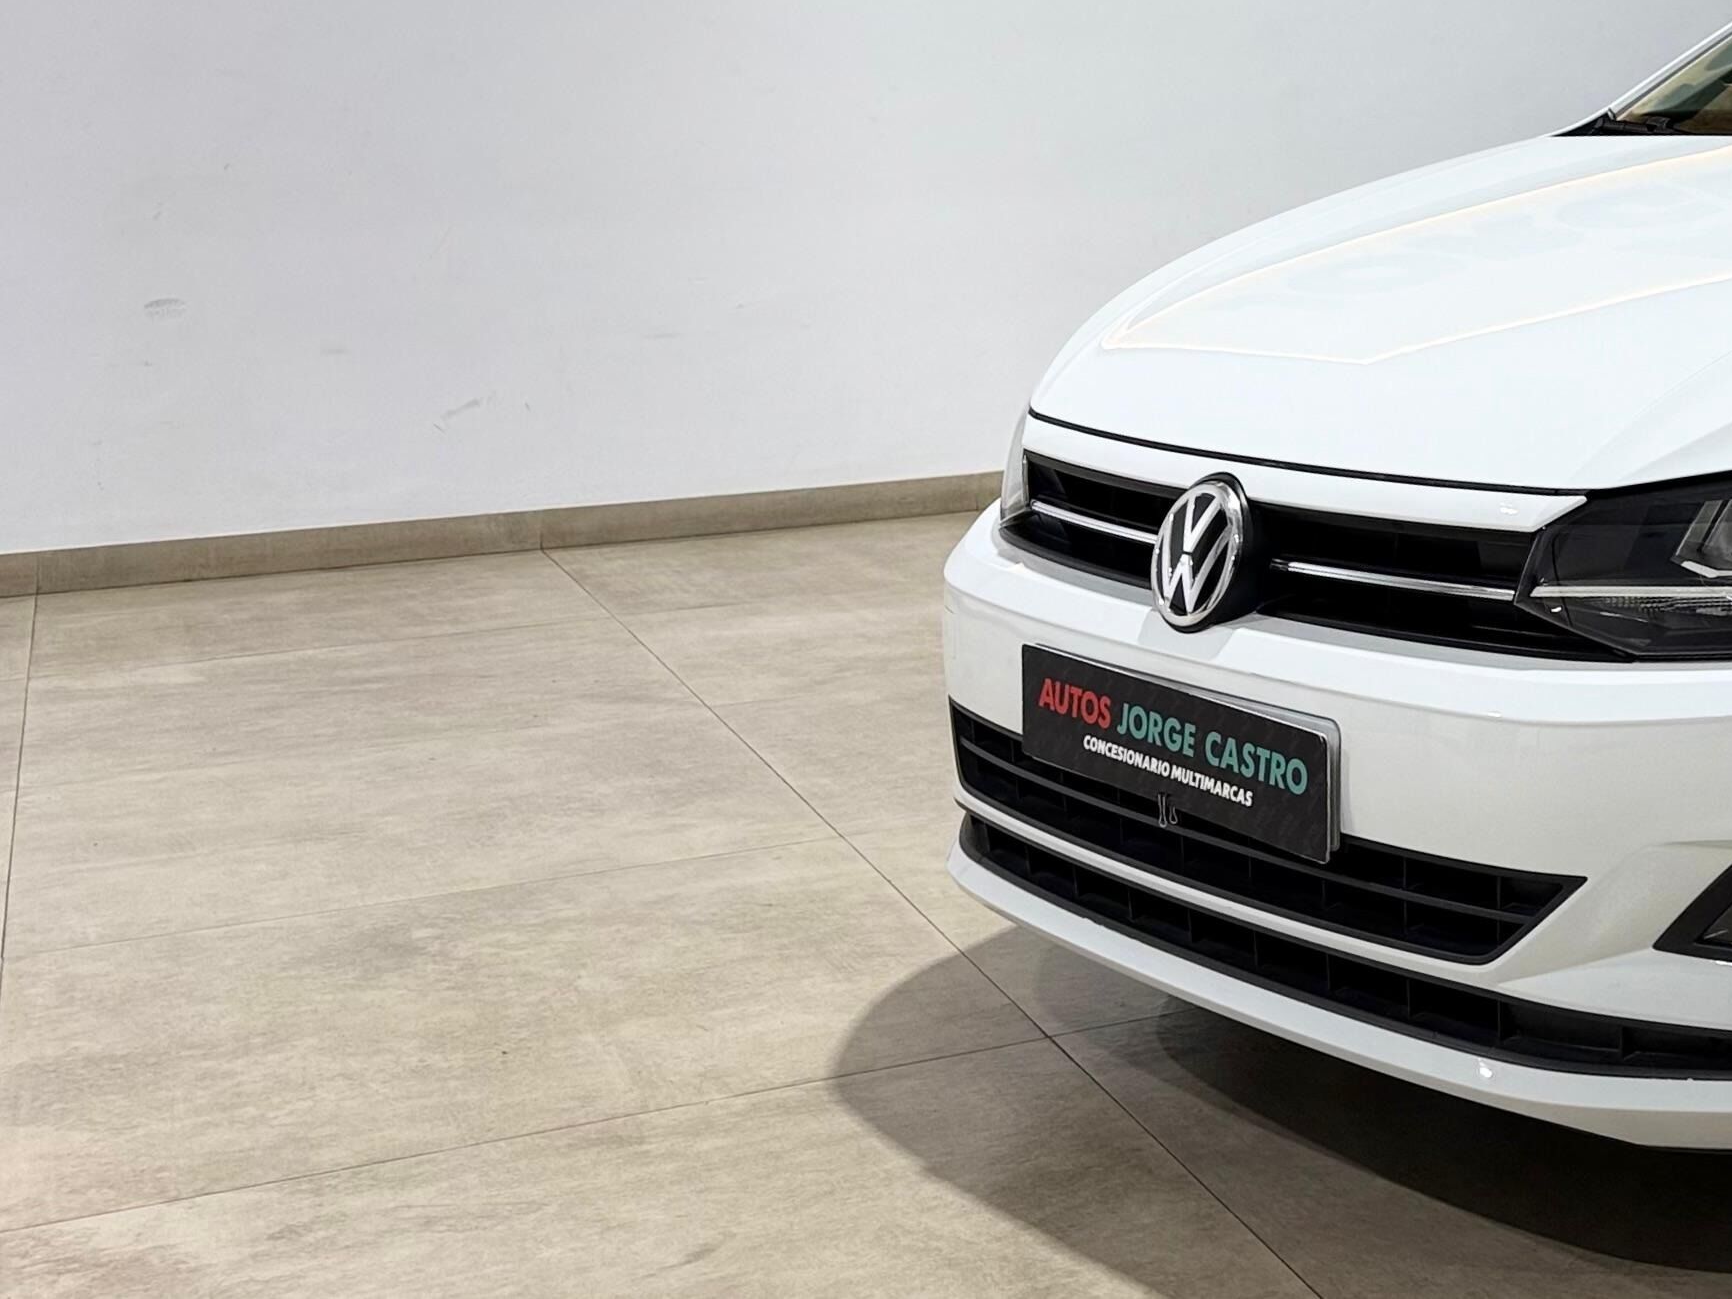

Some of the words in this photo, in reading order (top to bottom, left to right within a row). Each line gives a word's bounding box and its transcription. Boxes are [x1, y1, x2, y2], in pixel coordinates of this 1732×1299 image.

[1039, 678, 1112, 729] AUTOS
[1117, 703, 1196, 757] JORGE
[1205, 731, 1308, 795] CASTRO
[1083, 735, 1170, 778] CONCESIONARIO
[1171, 767, 1254, 807] MULTIMARCAS
